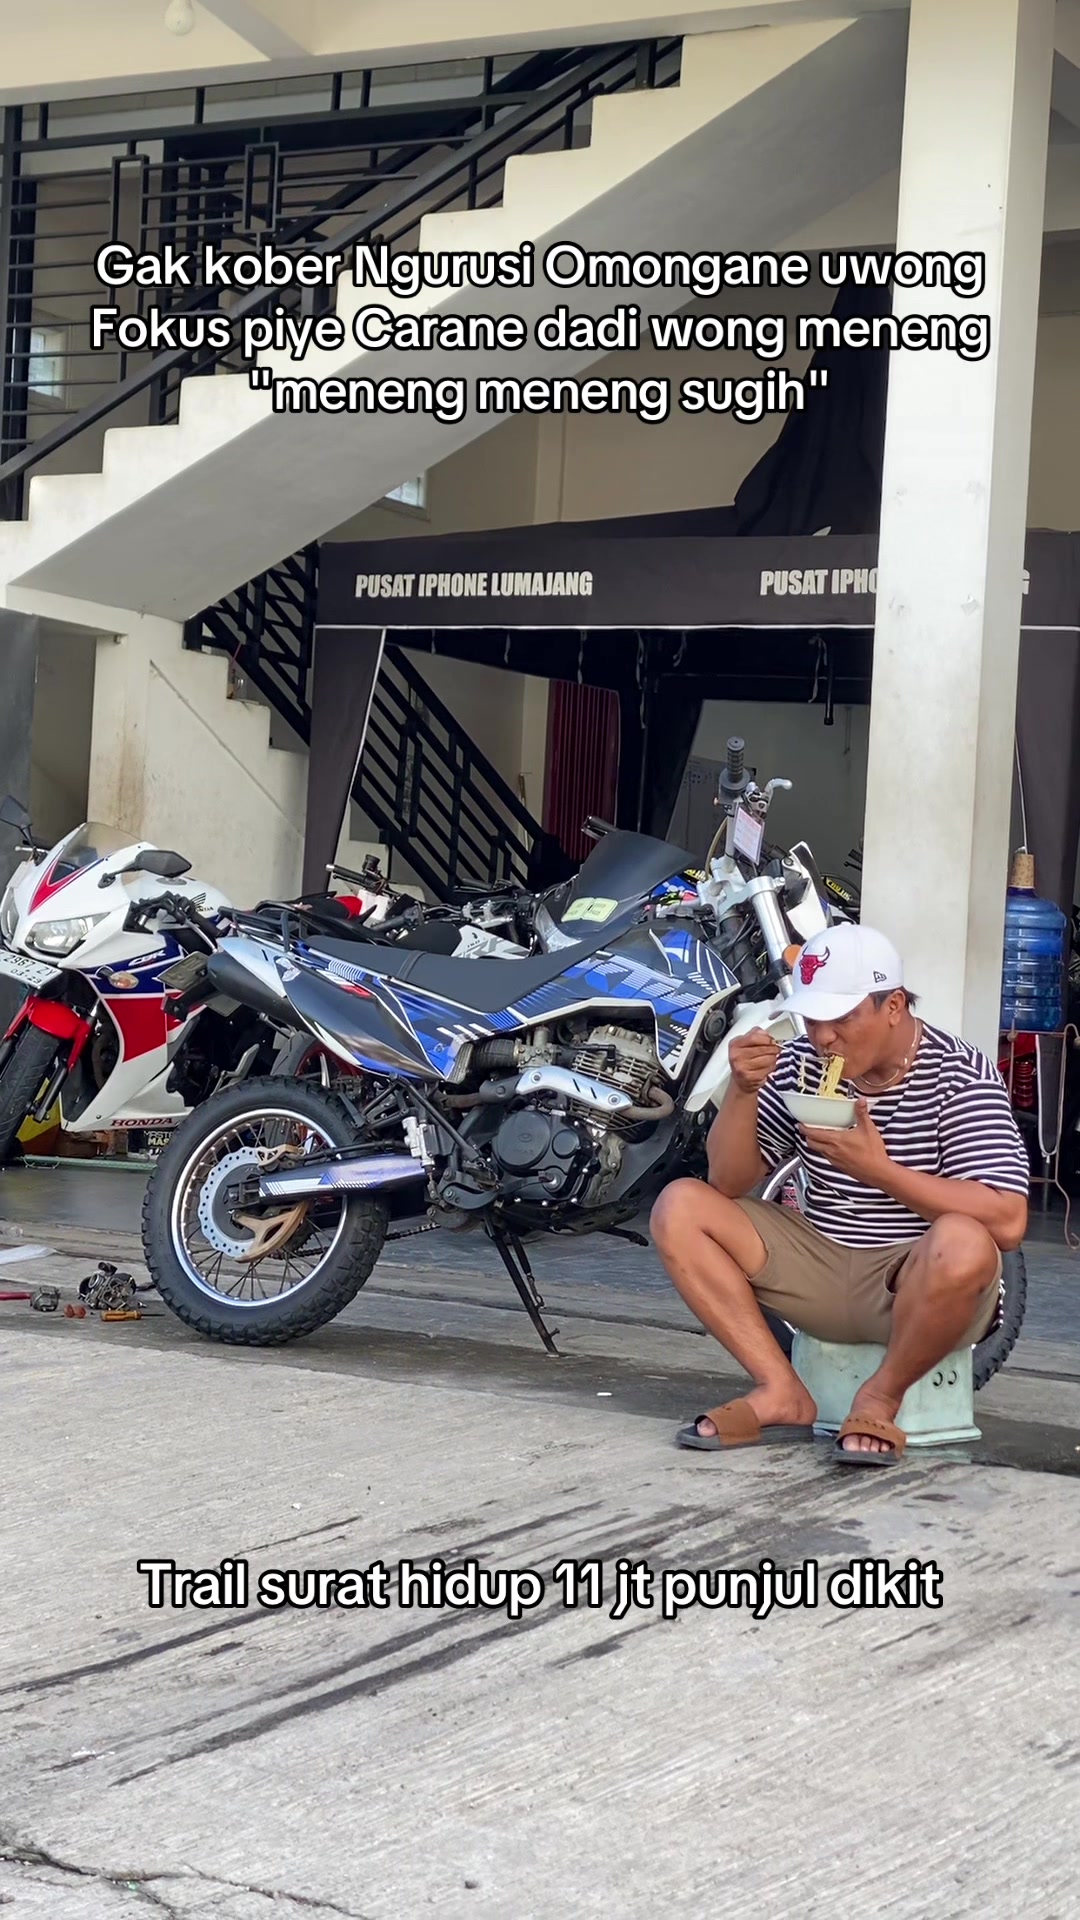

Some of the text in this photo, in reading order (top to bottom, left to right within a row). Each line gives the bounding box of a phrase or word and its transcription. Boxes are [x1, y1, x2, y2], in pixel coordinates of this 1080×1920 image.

[354, 571, 593, 598] PUSAT IPHONE LUMAJANG
[760, 569, 828, 596] PUSAT
[3, 953, 36, 969] 2967
[110, 1117, 173, 1127] HONDA
